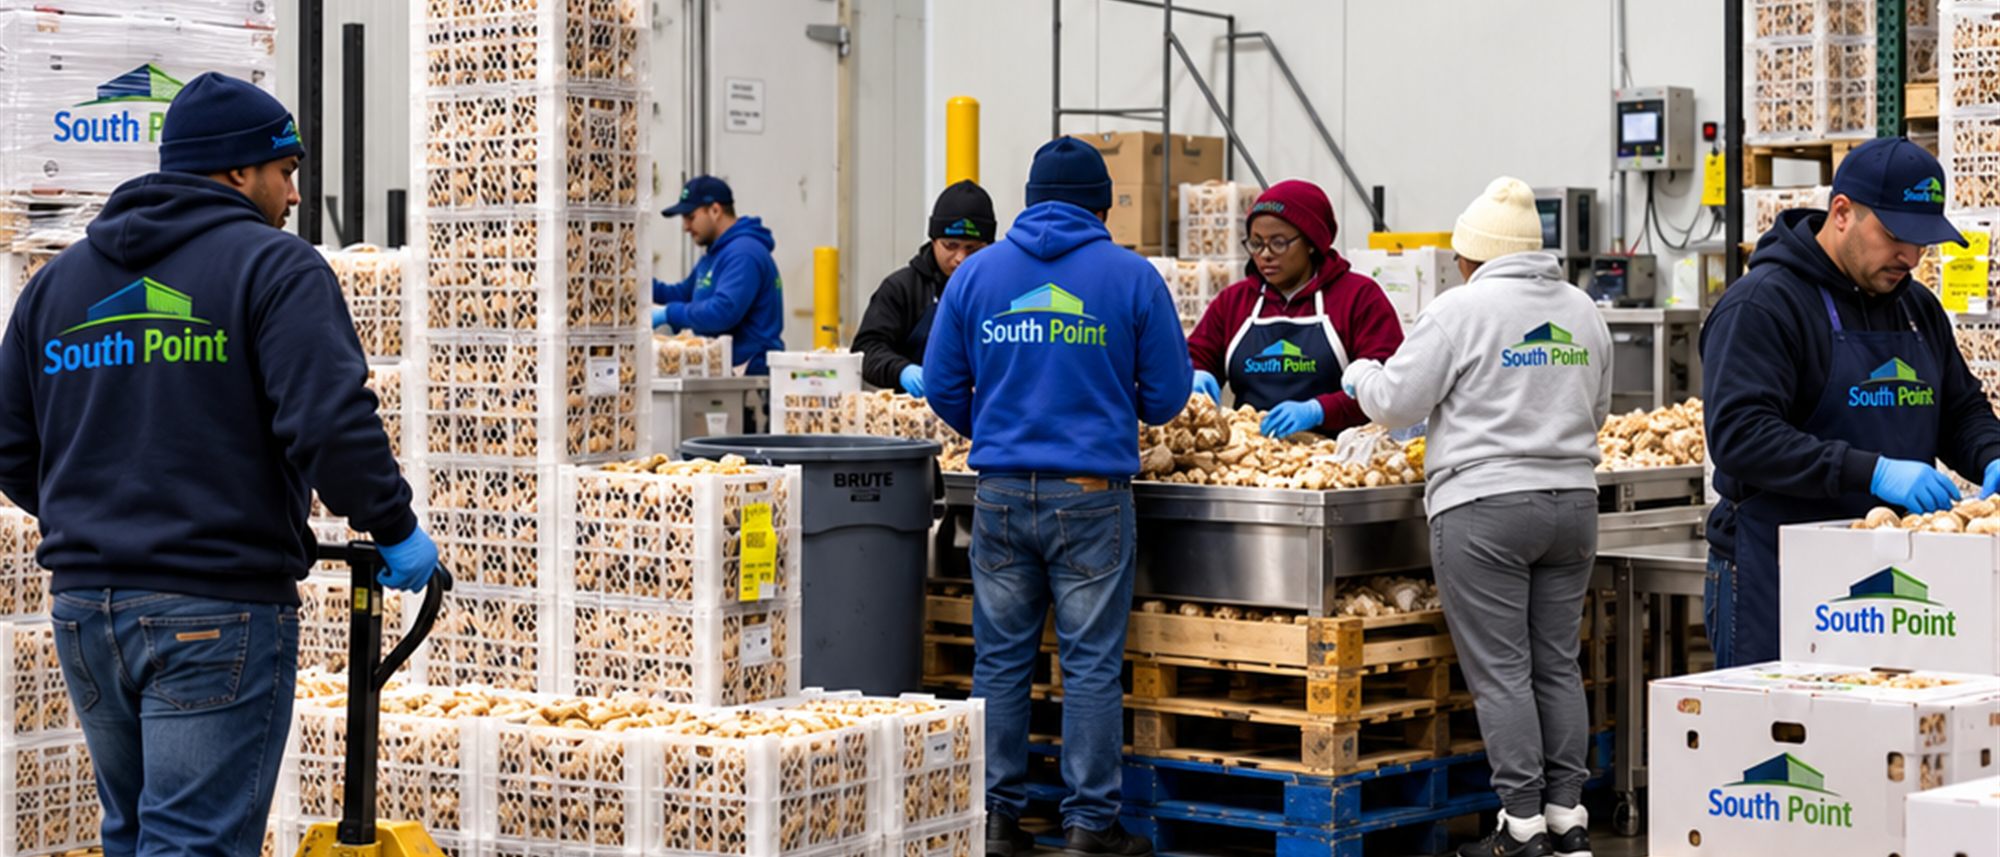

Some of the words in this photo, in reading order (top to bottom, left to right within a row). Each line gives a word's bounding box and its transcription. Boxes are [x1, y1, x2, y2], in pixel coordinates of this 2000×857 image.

[53, 110, 140, 142] South
[981, 317, 1043, 344] South
[1049, 318, 1107, 347] Point
[43, 330, 135, 375] South
[143, 327, 228, 363] Point
[1244, 357, 1282, 373] South
[1501, 346, 1548, 368] South
[1551, 347, 1589, 366] Point
[1848, 385, 1895, 407] South
[1897, 385, 1934, 406] Point
[833, 472, 894, 487] BRUTE
[1815, 604, 1885, 634] South
[1892, 607, 1956, 637] Point
[1708, 788, 1780, 821] South
[1788, 795, 1853, 828] Point
